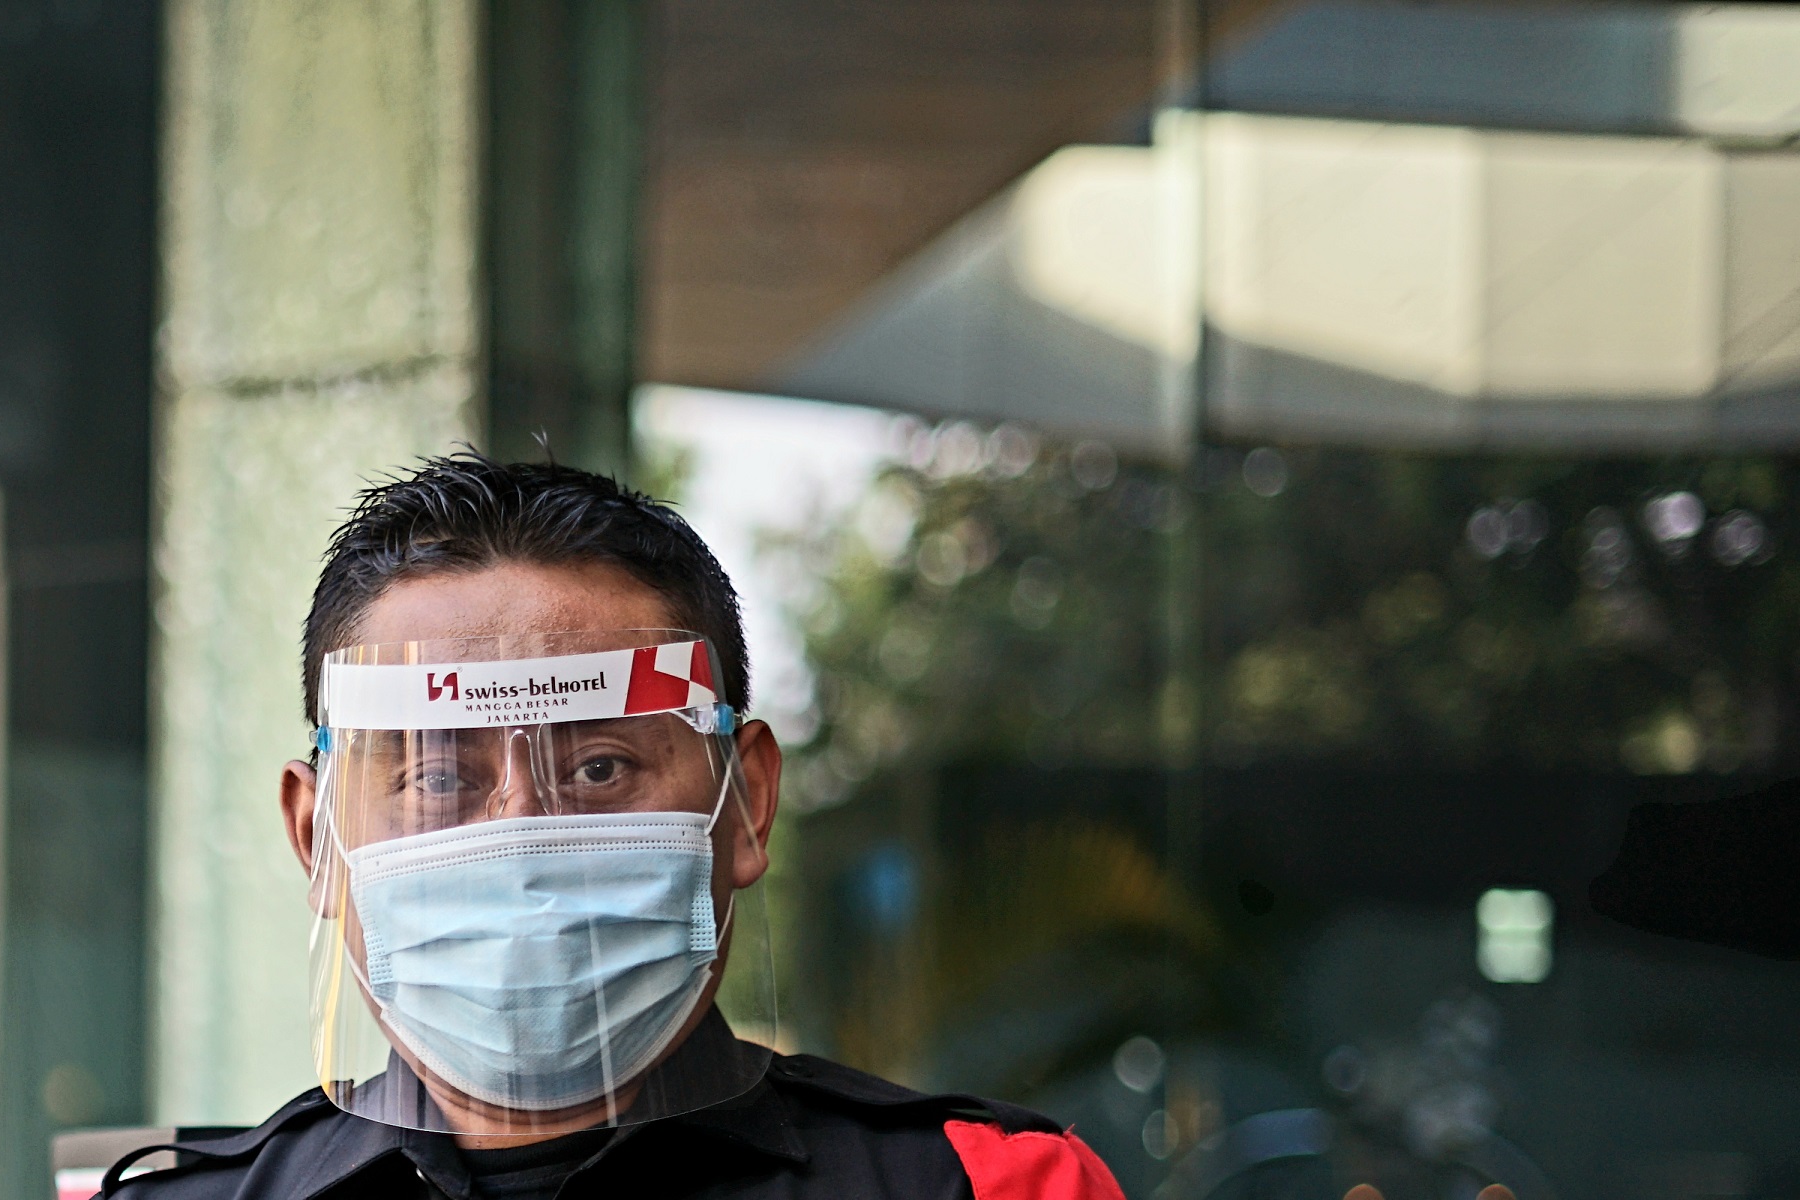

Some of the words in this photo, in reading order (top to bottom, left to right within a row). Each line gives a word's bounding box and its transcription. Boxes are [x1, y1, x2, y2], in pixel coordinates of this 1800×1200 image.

[465, 701, 522, 712] MANGGA
[526, 697, 569, 709] BESAR
[486, 711, 550, 724] JAKARTA
